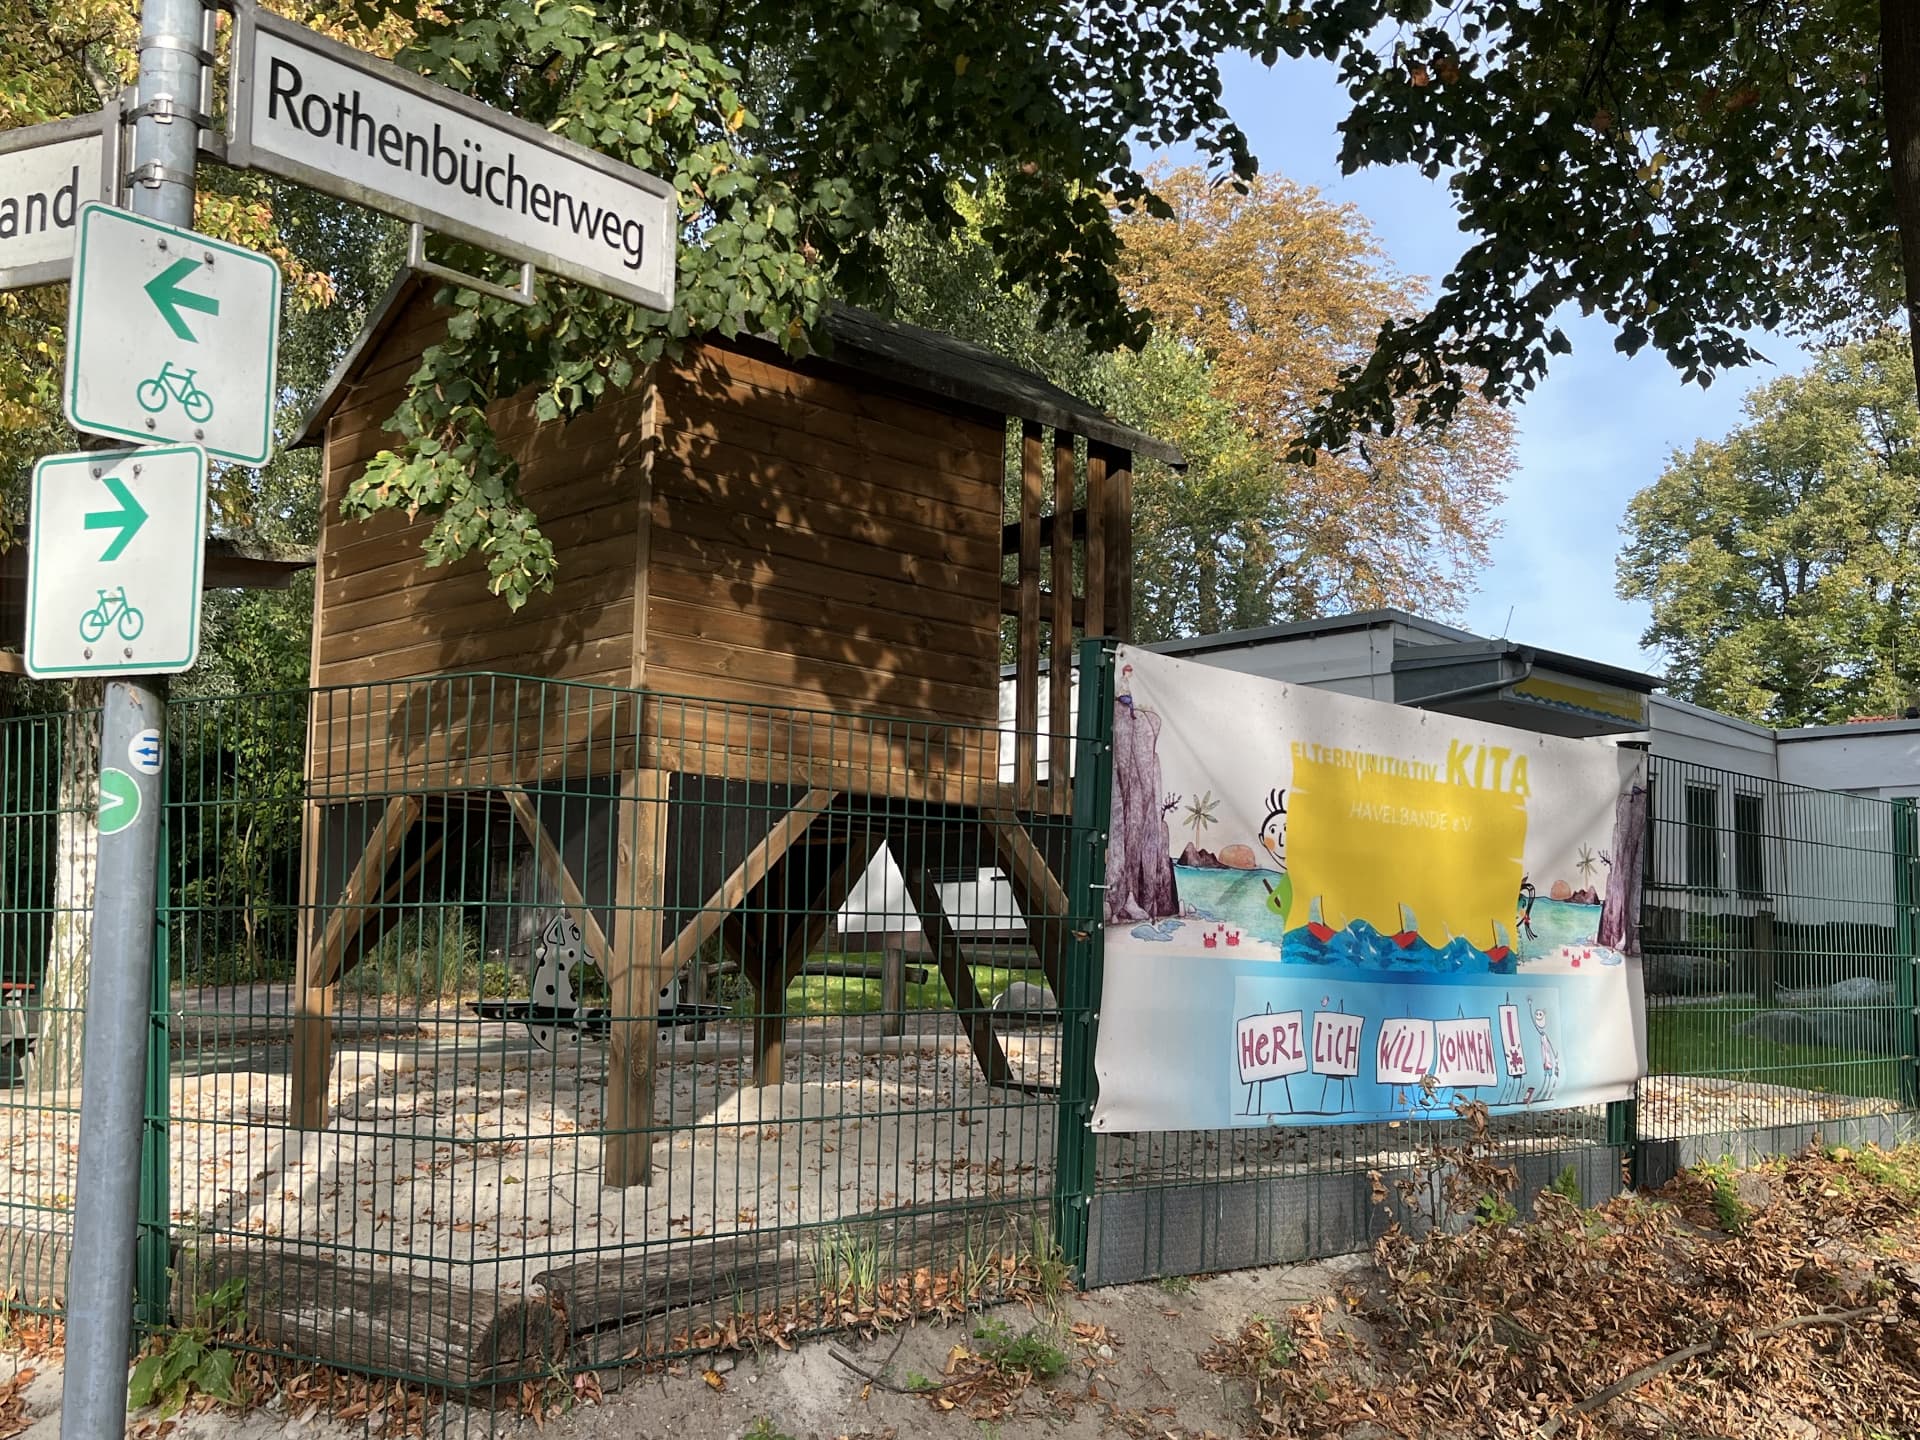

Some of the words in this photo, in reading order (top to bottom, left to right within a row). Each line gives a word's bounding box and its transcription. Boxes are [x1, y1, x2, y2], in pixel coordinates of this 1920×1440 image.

[267, 56, 645, 271] Rothenbücherweg
[0, 165, 80, 239] and
[1446, 738, 1531, 797] KITA
[1349, 800, 1449, 831] HAVELBANDE
